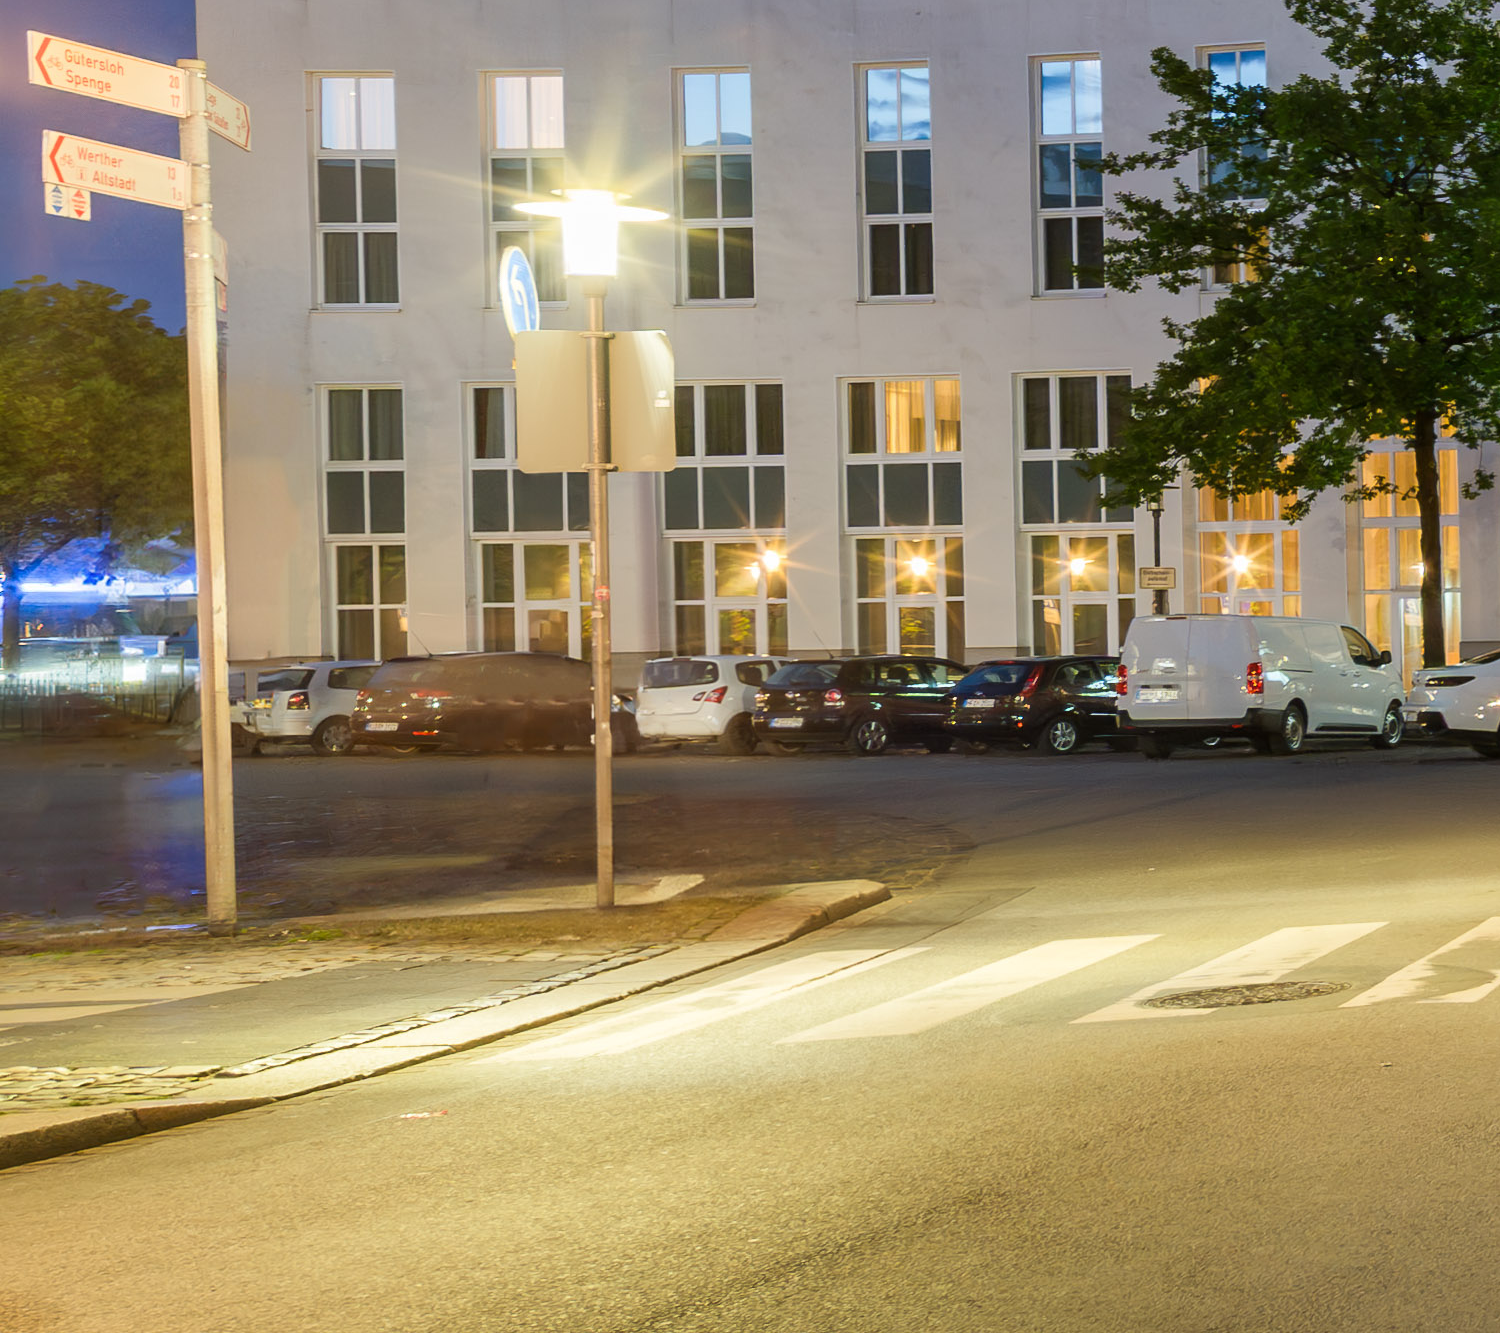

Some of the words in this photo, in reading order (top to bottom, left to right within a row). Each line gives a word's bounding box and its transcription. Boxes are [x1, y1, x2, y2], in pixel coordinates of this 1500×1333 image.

[64, 48, 125, 77] Gütersloh
[168, 74, 181, 90] 20
[66, 70, 112, 94] Spenge
[170, 94, 181, 108] 17
[77, 145, 124, 168] Werther
[167, 165, 177, 181] 13
[92, 170, 137, 192] Altstadt
